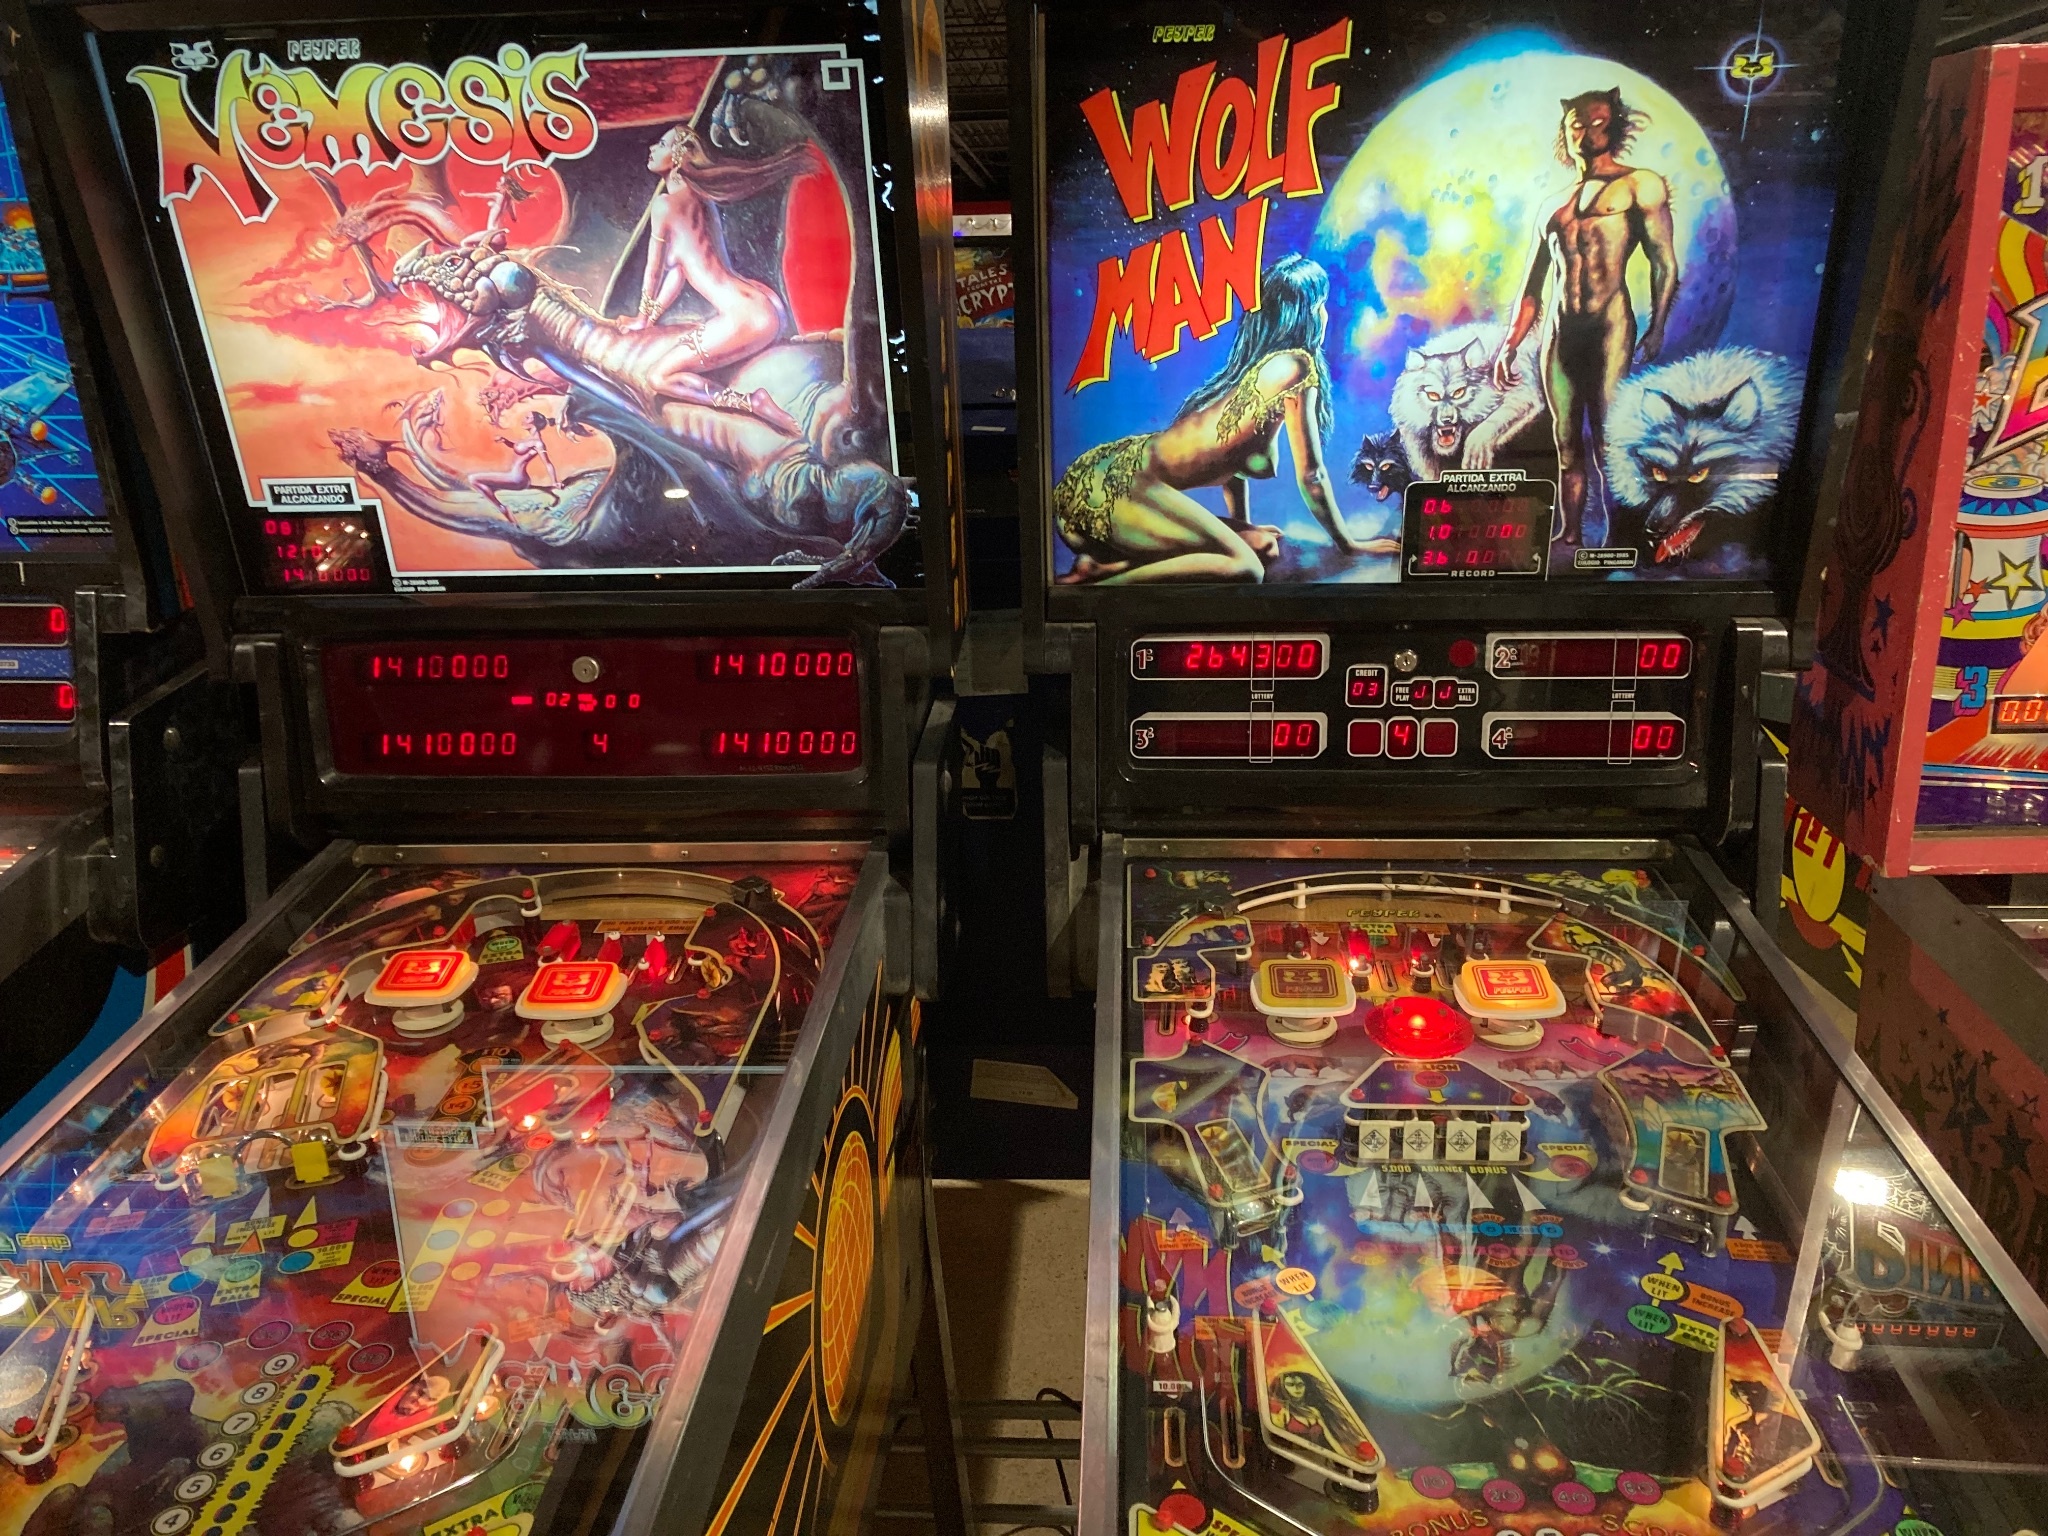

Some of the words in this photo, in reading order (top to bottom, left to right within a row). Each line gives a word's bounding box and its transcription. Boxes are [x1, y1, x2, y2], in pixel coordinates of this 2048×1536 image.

[1153, 24, 1215, 42] PEYPER
[288, 38, 361, 61] PEYPER
[1080, 17, 1353, 223] WOLF
[956, 263, 1008, 288] TALES
[1069, 197, 1270, 394] MAN
[1443, 474, 1485, 483] PARTIDA
[1489, 473, 1524, 482] EXTRA
[273, 485, 314, 495] PARTIDA
[315, 484, 349, 494] EXTRA
[1446, 483, 1517, 492] ALCANZANDO
[280, 494, 346, 505] ALCANZANDO
[50, 606, 66, 633] 0
[1185, 643, 1316, 669] 264300
[1639, 643, 1681, 669] 00
[372, 655, 509, 679] 1410000
[713, 652, 853, 677] 1410000
[1355, 669, 1379, 677] CREDIT
[58, 684, 74, 709] 0
[1352, 682, 1378, 696] 03
[1956, 665, 1989, 717] 3
[1395, 694, 1410, 702] PLAY
[719, 731, 857, 755] 1410000
[1274, 723, 1313, 747] 00
[1393, 724, 1410, 746] 4
[1633, 725, 1675, 750] 00
[382, 733, 516, 756] 1410000
[593, 733, 609, 754] 4
[1396, 1063, 1459, 1071] MLION
[1420, 1165, 1463, 1173] ADVANCE
[1469, 1166, 1508, 1175] BONUS
[1279, 1271, 1310, 1286] WHEN
[1648, 1276, 1681, 1292] WHEN
[1294, 1282, 1310, 1293] LIT
[1651, 1287, 1668, 1298] LIT
[335, 1293, 387, 1305] SPECIAL
[1692, 1297, 1735, 1317] INCREASE
[1700, 1292, 1731, 1308] BONUS
[1634, 1307, 1668, 1325] WHEN
[1638, 1319, 1655, 1331] LIT
[135, 1328, 198, 1344] SPECIAL
[272, 1358, 287, 1371] 9
[251, 1387, 268, 1400] 8
[231, 1417, 248, 1430] 7
[209, 1448, 225, 1461] 6
[186, 1479, 204, 1494] 5
[1422, 1474, 1448, 1489] 10
[1489, 1487, 1522, 1503] 20
[162, 1514, 181, 1528] 4
[1602, 1514, 1684, 1536] SCO
